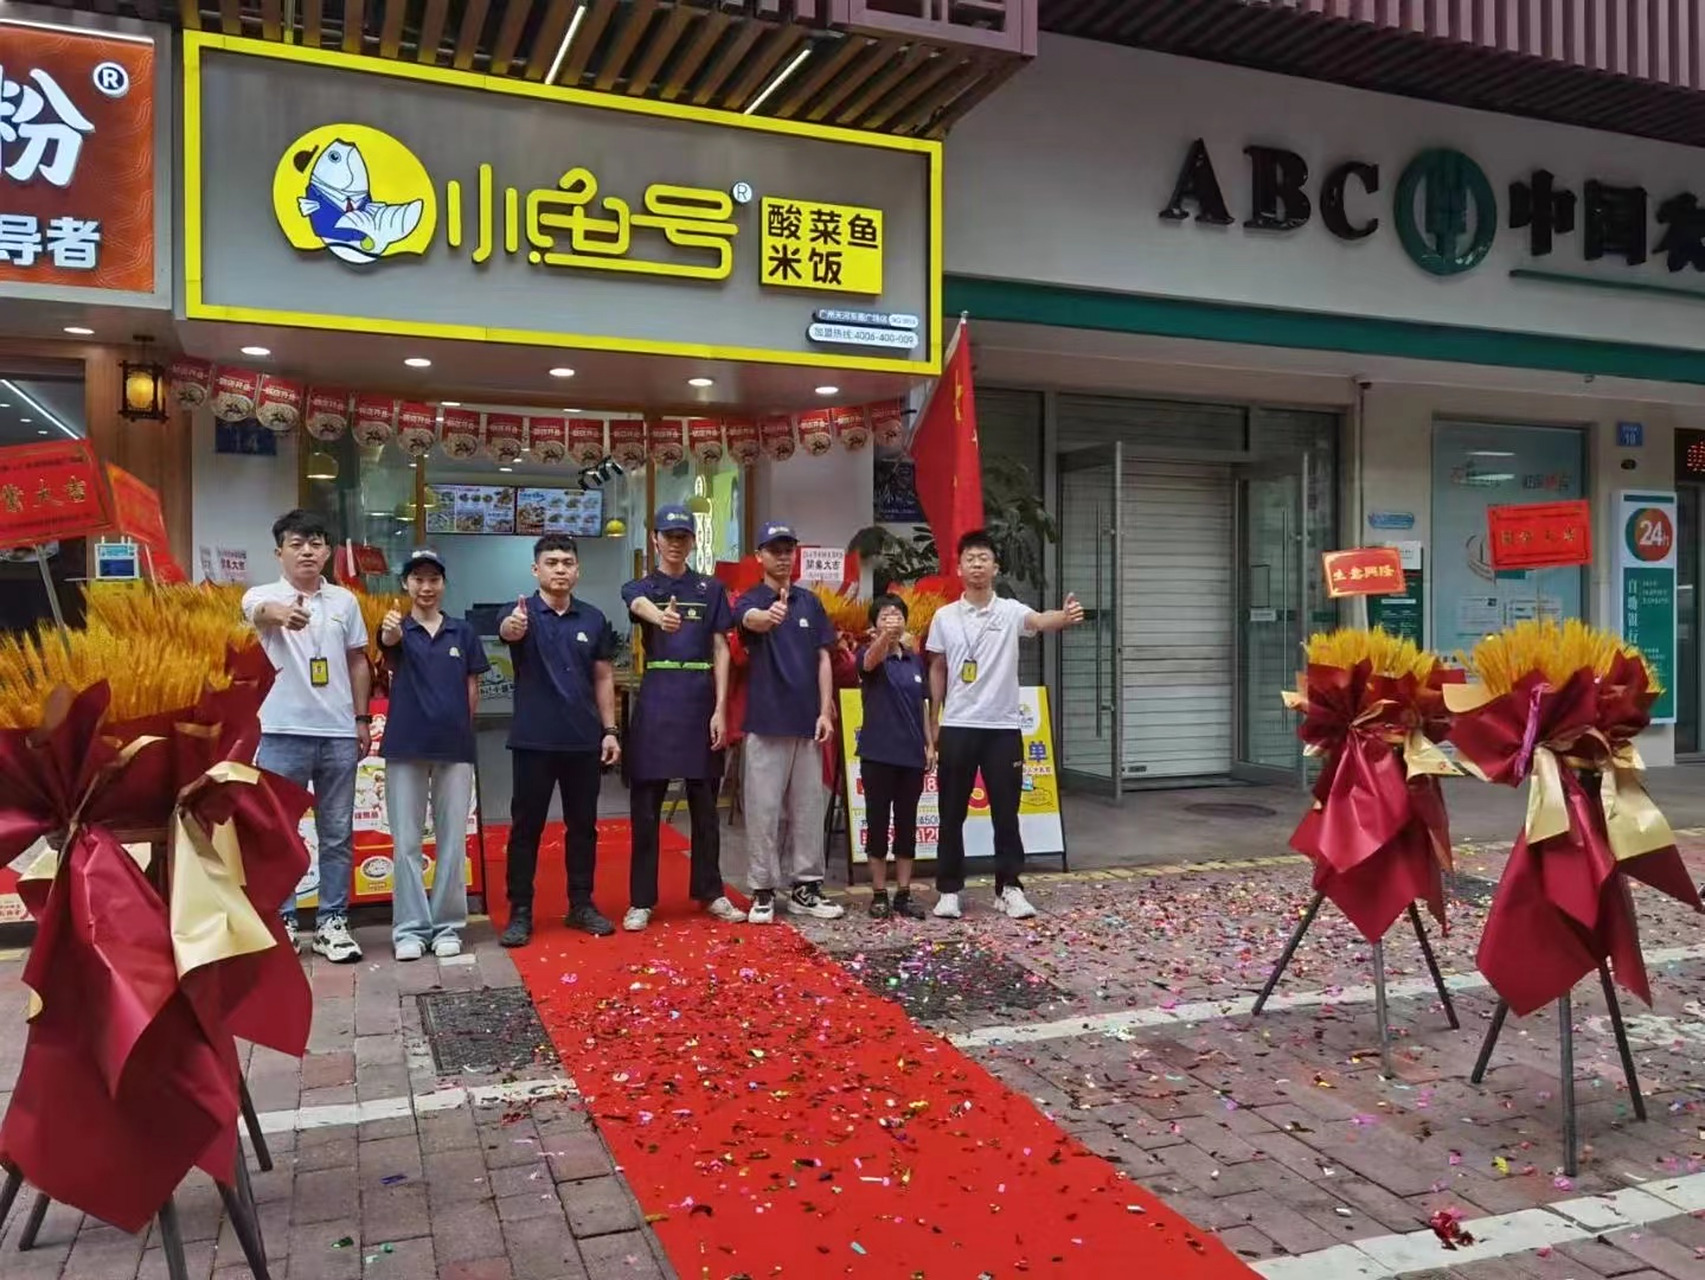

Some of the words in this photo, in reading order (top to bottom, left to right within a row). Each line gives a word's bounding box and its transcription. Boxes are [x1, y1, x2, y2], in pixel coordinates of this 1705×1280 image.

[1159, 138, 1380, 240] ABC
[767, 203, 878, 249] 酸菜鱼
[768, 244, 842, 285] 米饭
